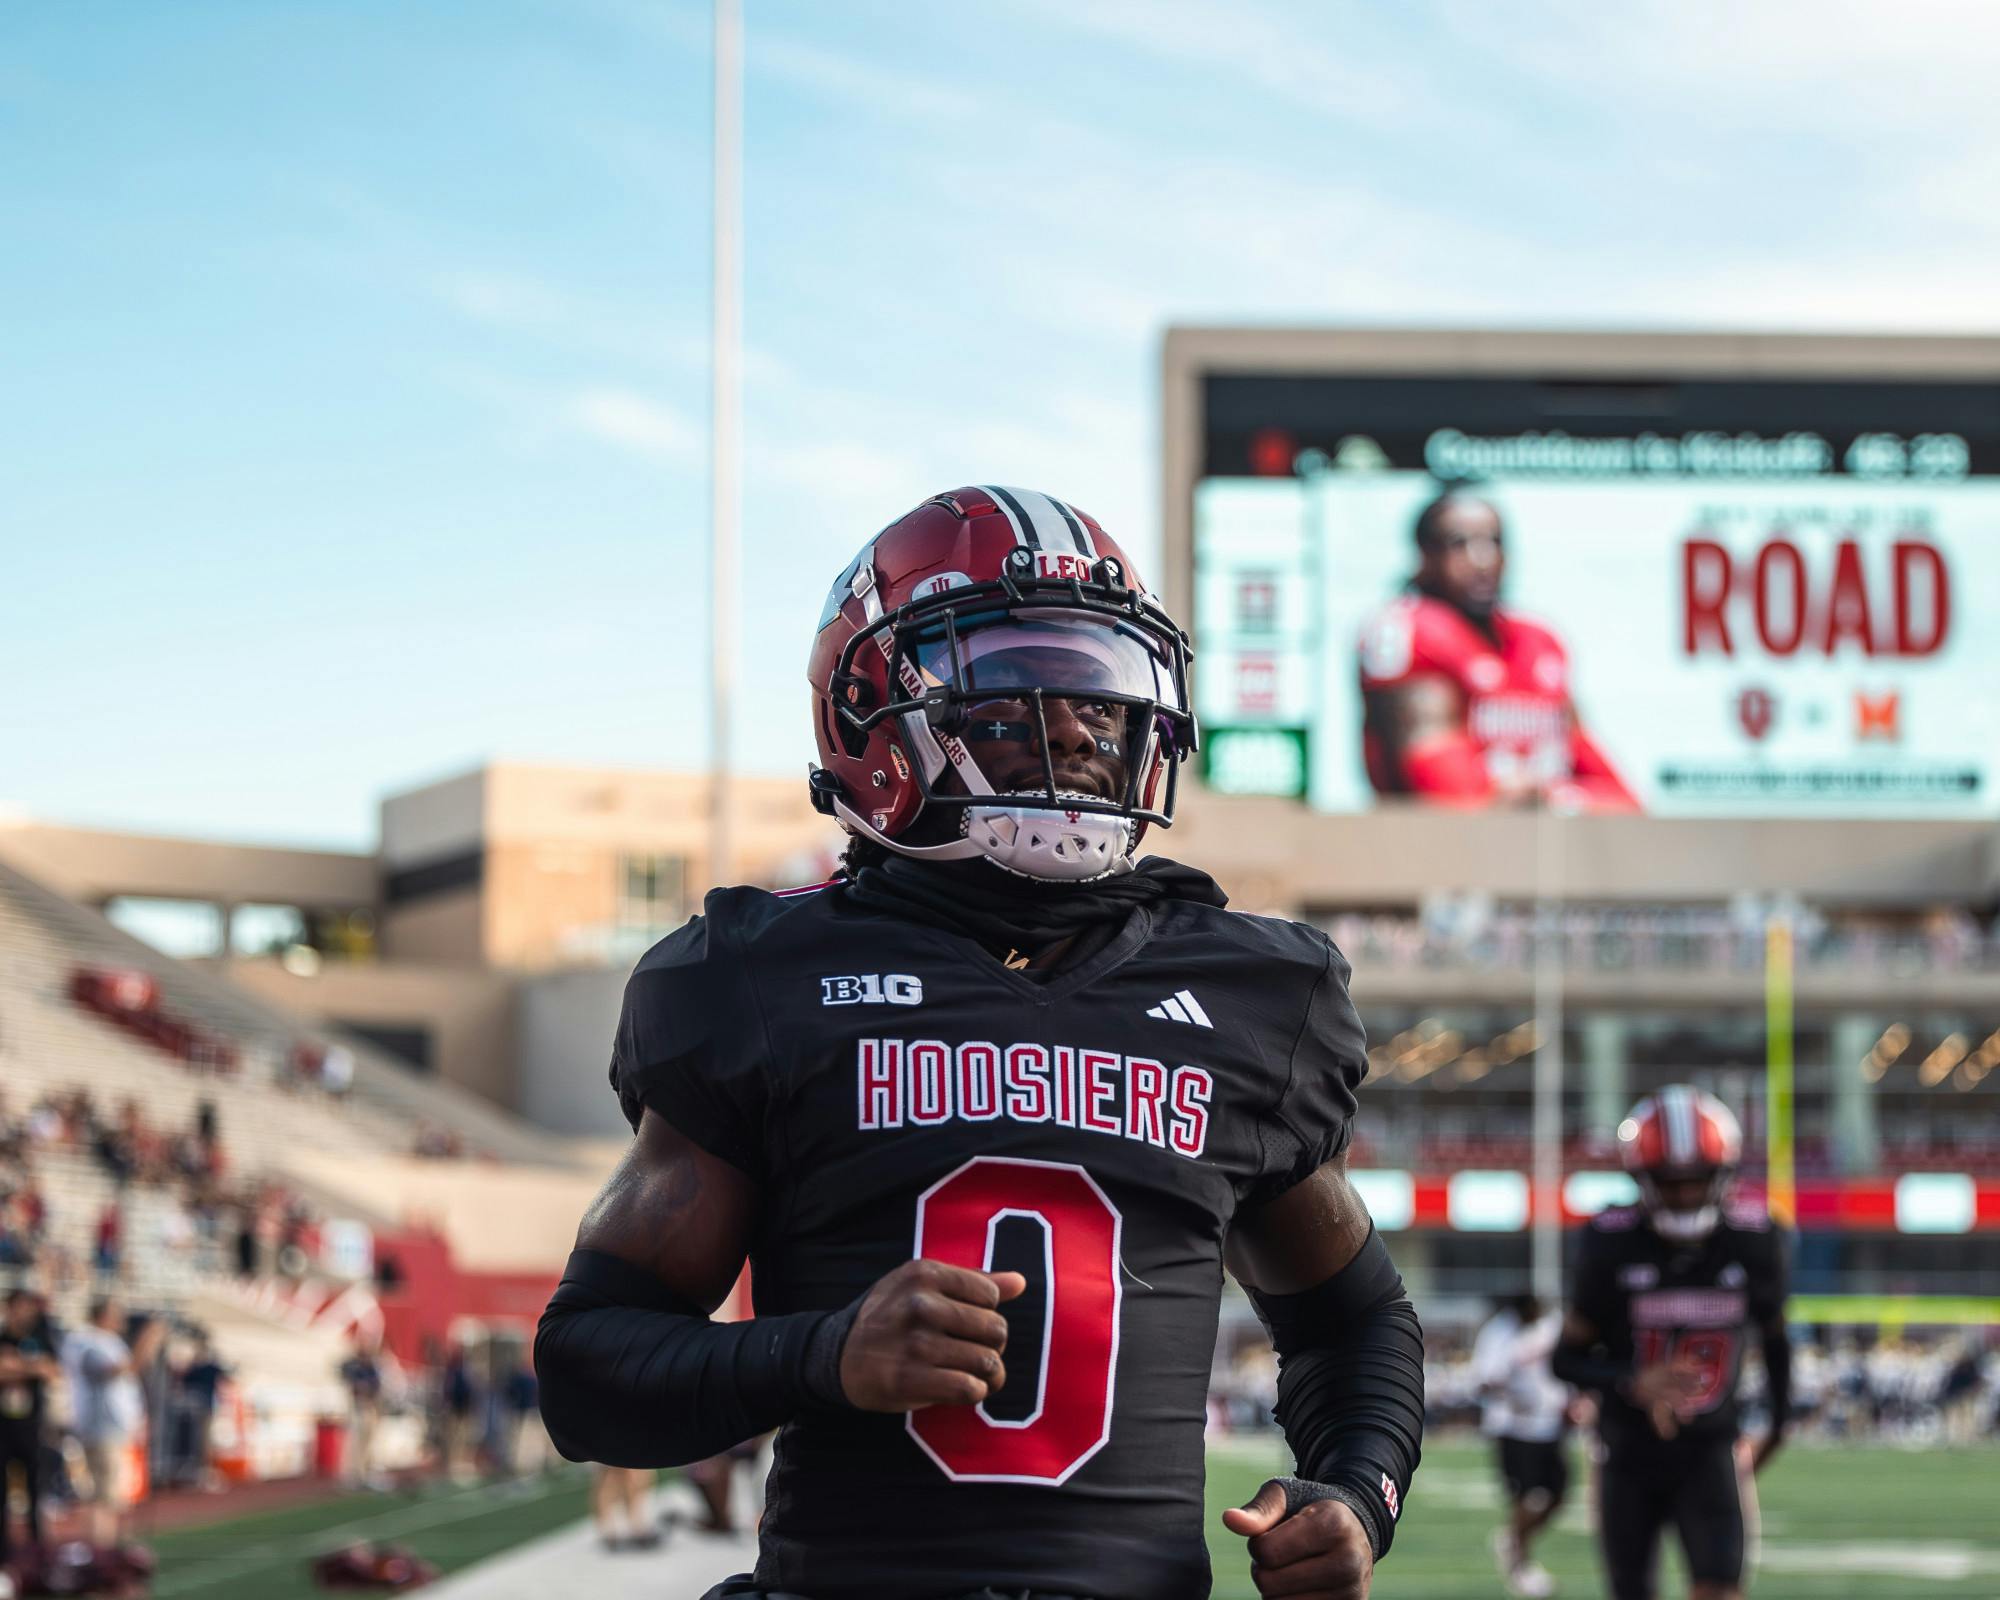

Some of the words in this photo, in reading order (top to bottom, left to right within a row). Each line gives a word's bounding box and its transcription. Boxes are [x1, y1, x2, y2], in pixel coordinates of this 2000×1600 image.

[1038, 555, 1091, 582] LEO
[1683, 538, 1954, 660] ROAD
[880, 637, 923, 699] INANA
[858, 1038, 1214, 1159] HOOSIERS
[905, 1155, 1123, 1488] 0
